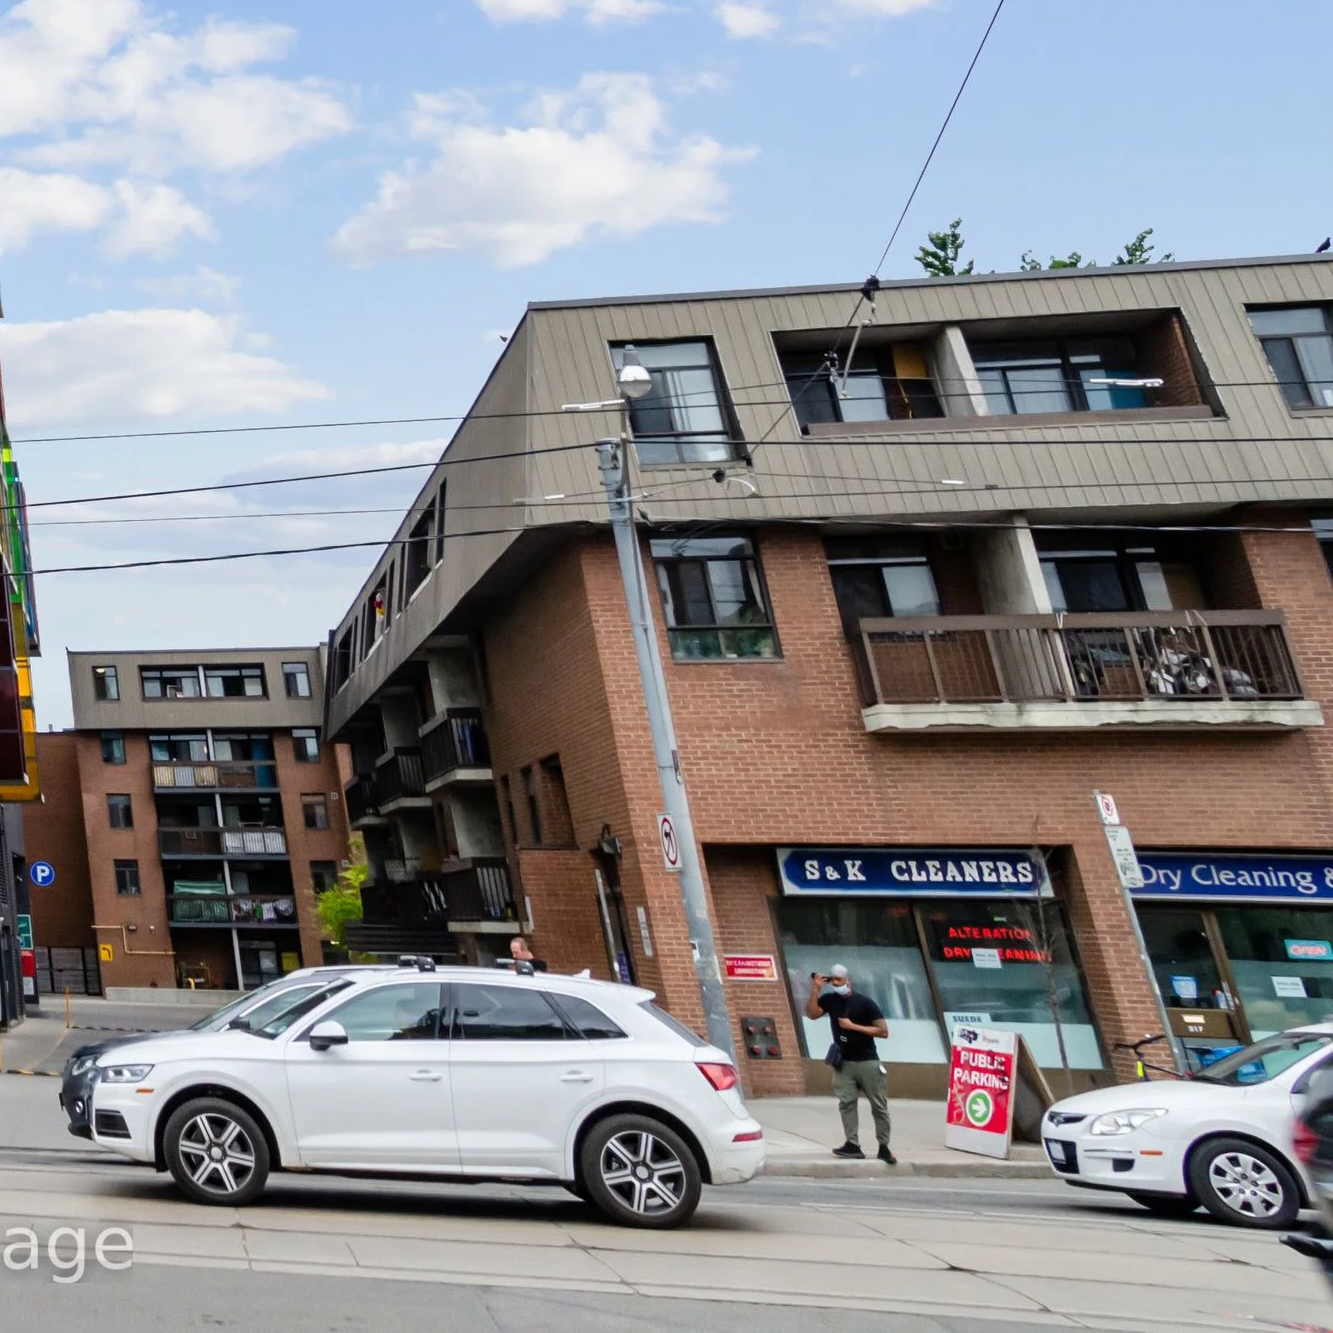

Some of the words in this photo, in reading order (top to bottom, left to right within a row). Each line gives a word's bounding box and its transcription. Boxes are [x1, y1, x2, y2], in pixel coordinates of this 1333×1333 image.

[36, 865, 50, 883] P
[805, 860, 820, 880] S
[826, 865, 841, 880] &
[843, 860, 866, 881] K
[890, 860, 1033, 883] CLEANERS
[1137, 864, 1182, 890] Dry
[1191, 864, 1318, 894] Cleaning
[943, 947, 971, 958] DRY
[960, 1051, 1006, 1071] PUBLIC
[954, 1068, 1009, 1090] PARKING
